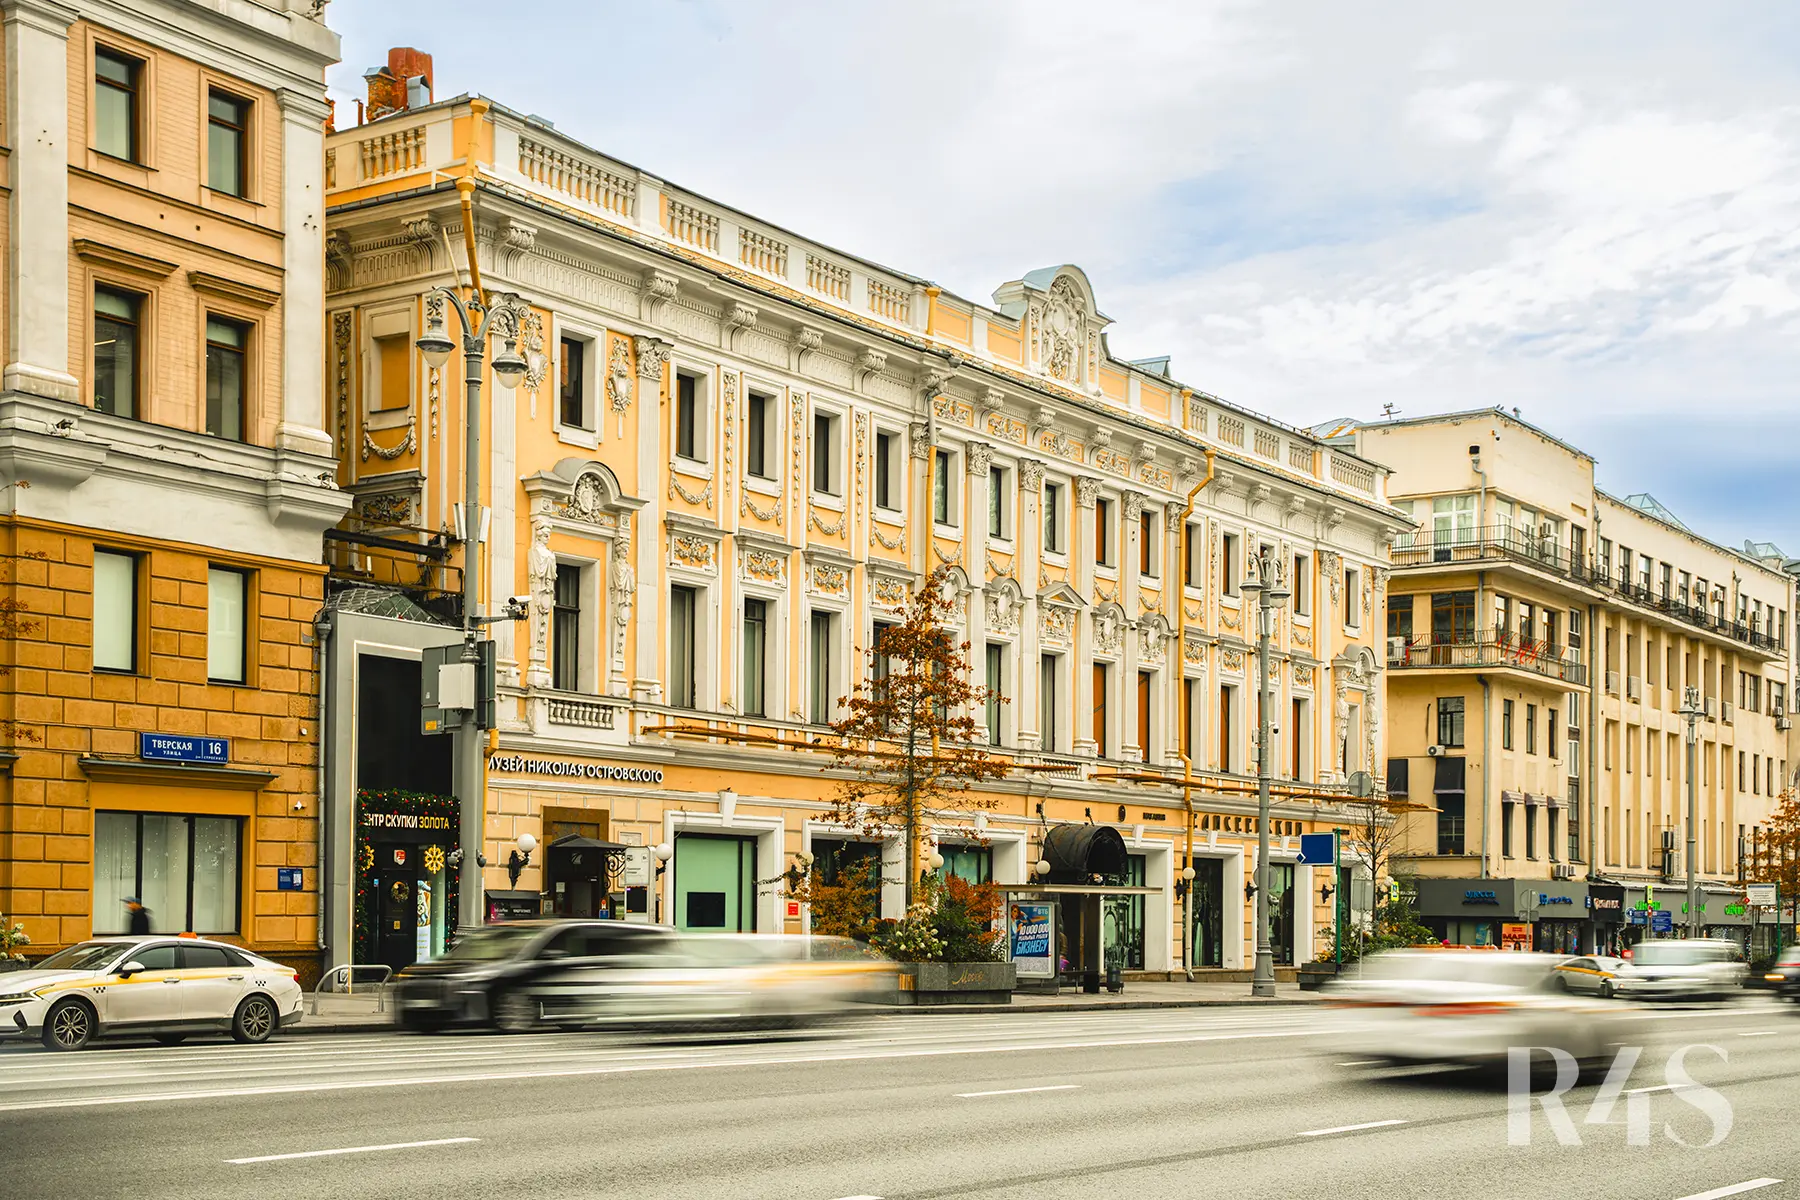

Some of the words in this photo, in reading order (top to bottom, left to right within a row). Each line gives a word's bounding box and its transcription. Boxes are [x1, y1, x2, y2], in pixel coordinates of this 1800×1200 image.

[152, 739, 192, 751] ТВЕРСКАЯ
[208, 742, 222, 755] 16
[527, 760, 585, 777] НИКОЛАЯ
[586, 765, 664, 783] ОСТРОВСКОГО
[385, 814, 418, 828] СКУПКИ
[419, 816, 450, 830] ЗОЛОТА
[1016, 940, 1048, 955] БИЗНЕСУ
